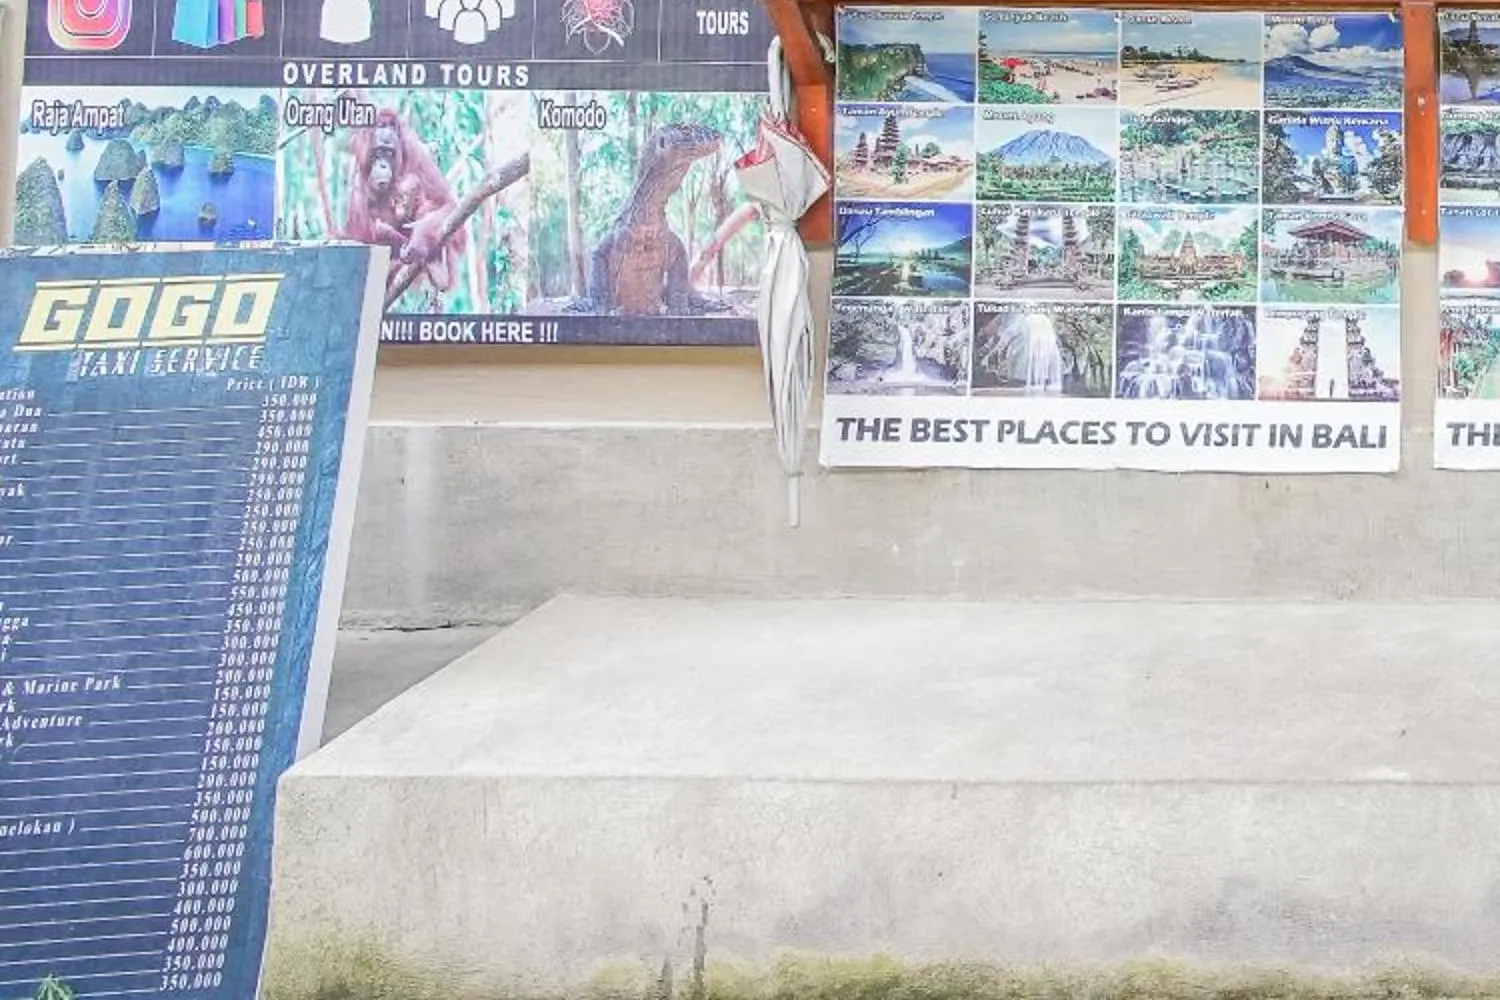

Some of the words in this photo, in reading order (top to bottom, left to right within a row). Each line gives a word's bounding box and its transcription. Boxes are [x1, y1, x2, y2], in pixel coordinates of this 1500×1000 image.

[696, 10, 749, 35] TOURS
[282, 63, 425, 86] OVERLAND
[440, 65, 530, 88] TOURS
[31, 101, 68, 135] Raja
[71, 103, 125, 136] Ampat
[284, 98, 333, 128] Orang
[337, 100, 375, 125] Utan
[539, 100, 607, 129] Komodo
[13, 273, 286, 352] GOGO
[419, 321, 476, 342] BOOK
[481, 321, 534, 343] HERE
[80, 349, 139, 378] TAXI
[150, 345, 265, 377] SERVICE
[226, 376, 266, 391] Price
[836, 417, 902, 444] THE
[909, 417, 990, 445] BEST
[996, 418, 1117, 447] PLACES
[1124, 420, 1171, 447] TO
[1178, 421, 1262, 448] VISIT
[1267, 423, 1304, 449] IN
[1310, 424, 1388, 450] BALI
